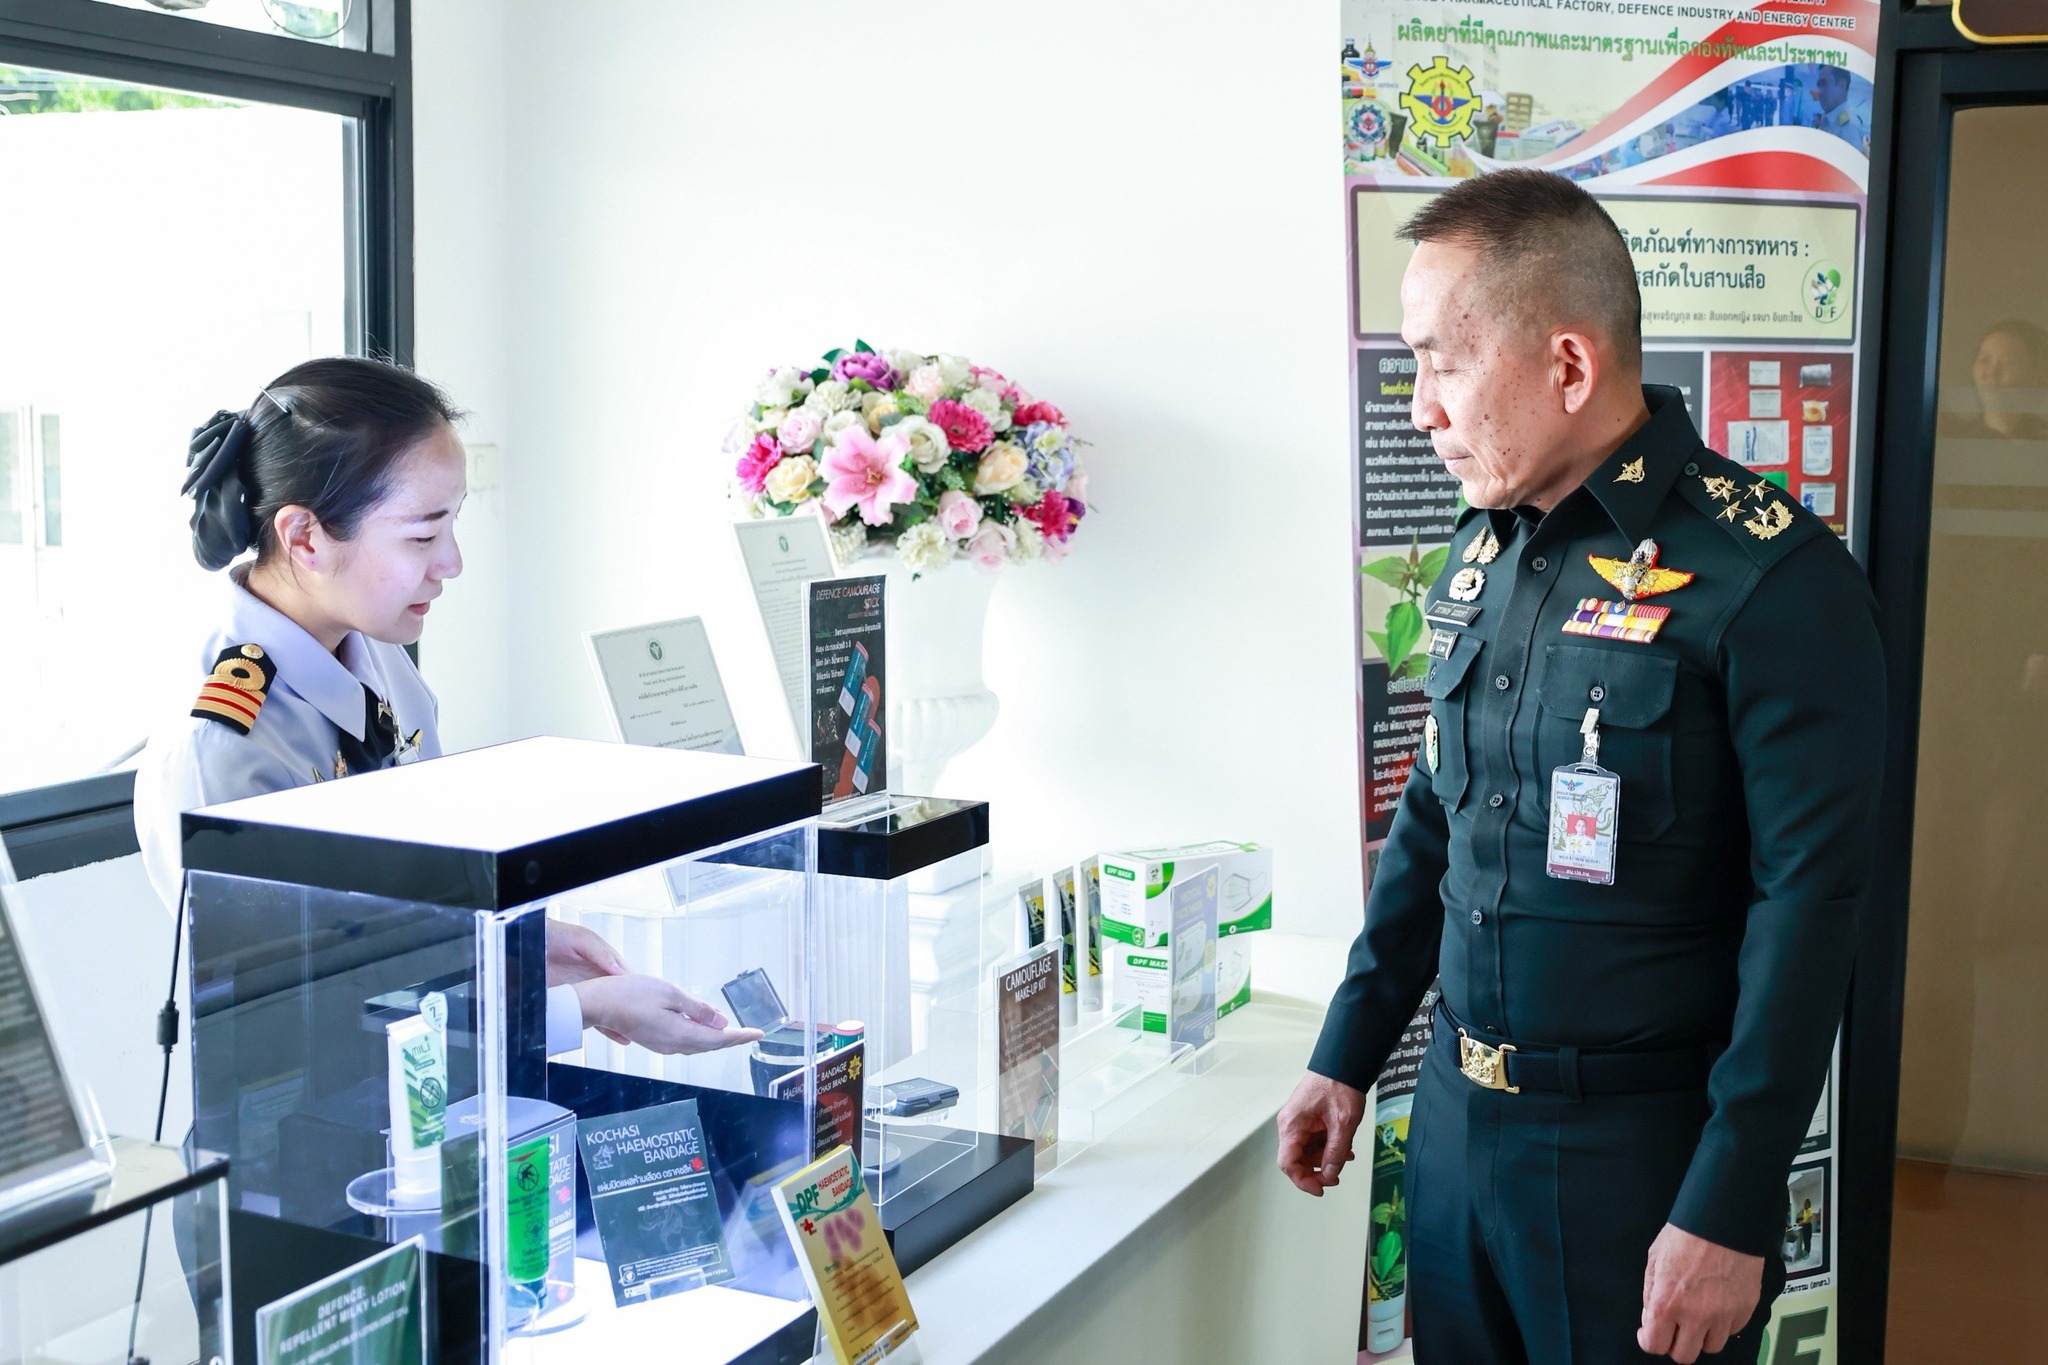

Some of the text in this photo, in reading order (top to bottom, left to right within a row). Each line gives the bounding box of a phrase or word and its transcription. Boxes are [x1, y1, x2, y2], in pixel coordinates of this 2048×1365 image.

[1556, 0, 1614, 14] FACTORY,
[1618, 3, 1674, 17] DEFENCE
[1677, 7, 1735, 20] INDUSTRY
[1737, 11, 1761, 22] AND
[1764, 13, 1810, 26] ENERGY
[1812, 16, 1855, 29] CENTRE
[816, 588, 842, 601] DEFENCE
[1106, 866, 1133, 879] DPF MASK
[1133, 957, 1148, 966] DPF
[1006, 956, 1052, 992] CAMOUFLAGE
[1015, 977, 1047, 1003] MAKE-UP KIT
[821, 1061, 848, 1080] BANDAGE
[1398, 1064, 1416, 1075] ether
[832, 1075, 848, 1088] BRAND
[586, 1124, 640, 1146] KOCHASI
[616, 1128, 698, 1155] HAEMOSTATIC
[643, 1141, 701, 1164] BANDAGE
[795, 1183, 820, 1216] DPF
[817, 1165, 850, 1190] HAEMOSTATIC
[831, 1177, 854, 1197] BANDAGE
[279, 1280, 406, 1354] REPELLENT MILKY LOTION
